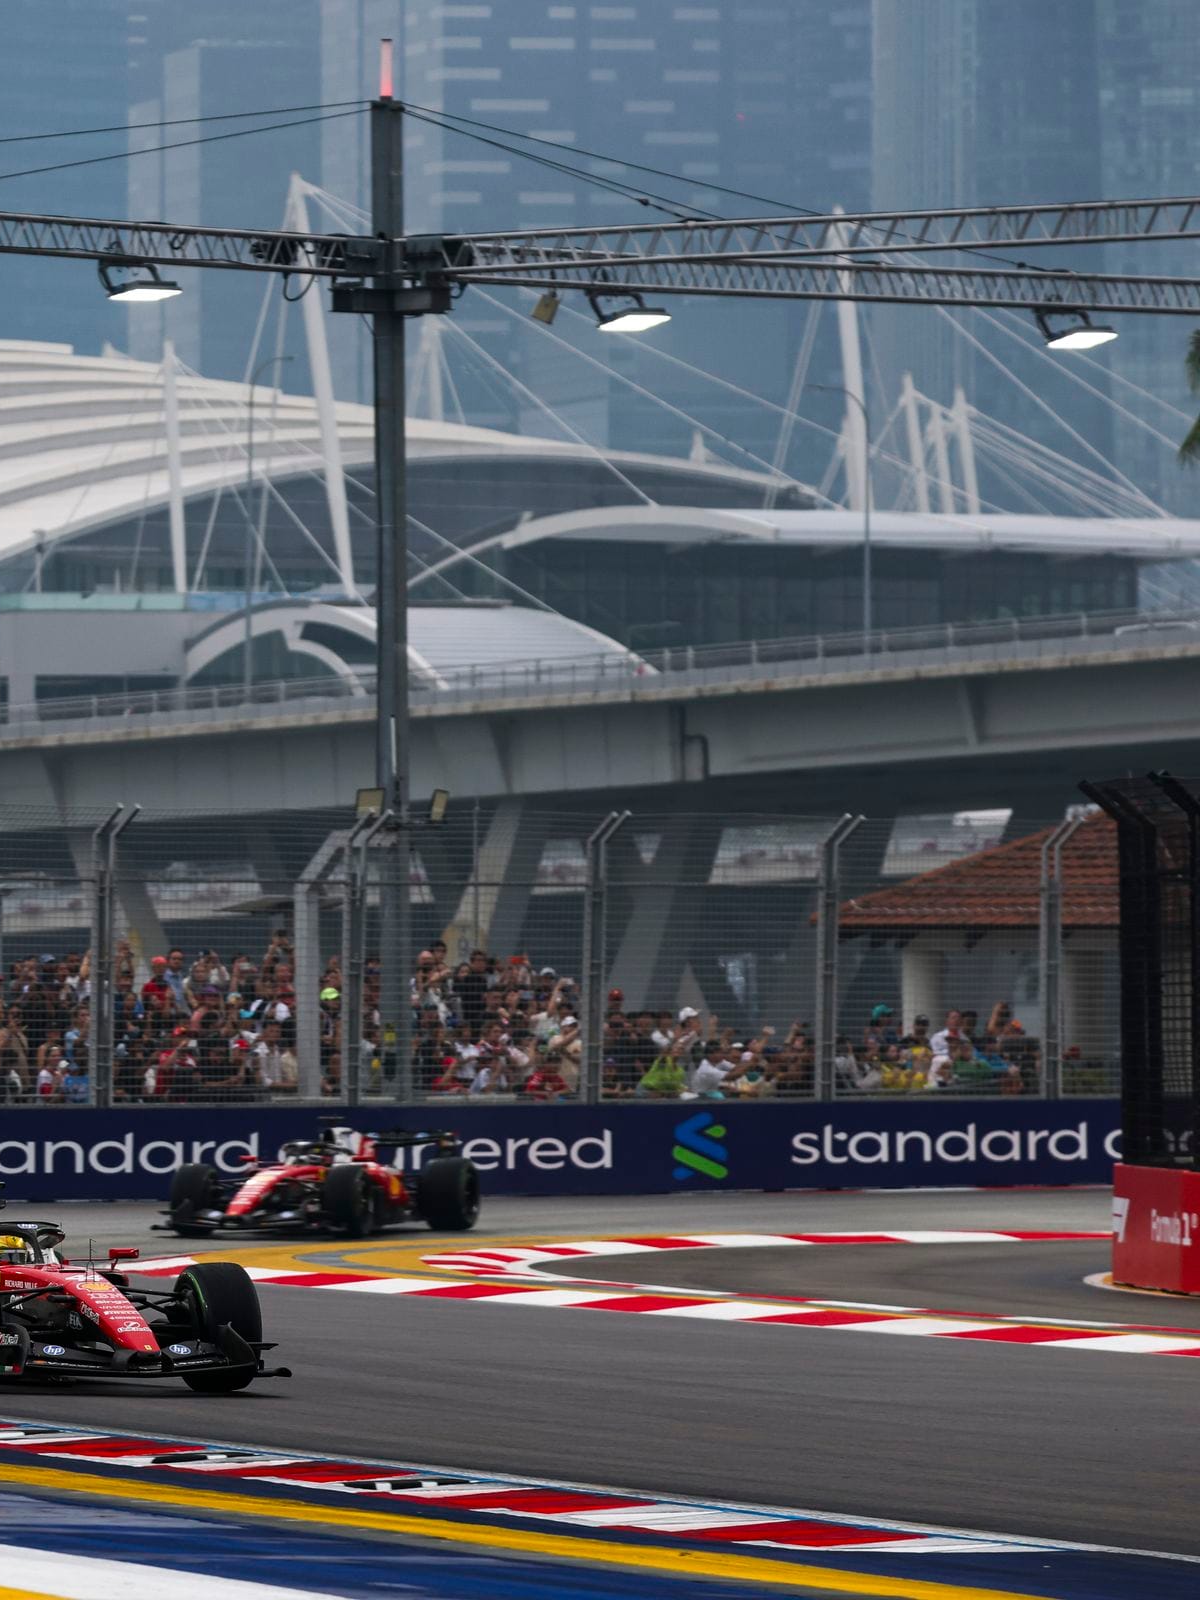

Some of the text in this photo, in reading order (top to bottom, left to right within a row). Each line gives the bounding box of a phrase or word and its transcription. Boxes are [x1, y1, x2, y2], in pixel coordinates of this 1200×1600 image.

[792, 1123, 1087, 1164] standard
[4, 1279, 23, 1289] RICHARD
[46, 1345, 63, 1355] hp
[172, 1345, 188, 1354] hp
